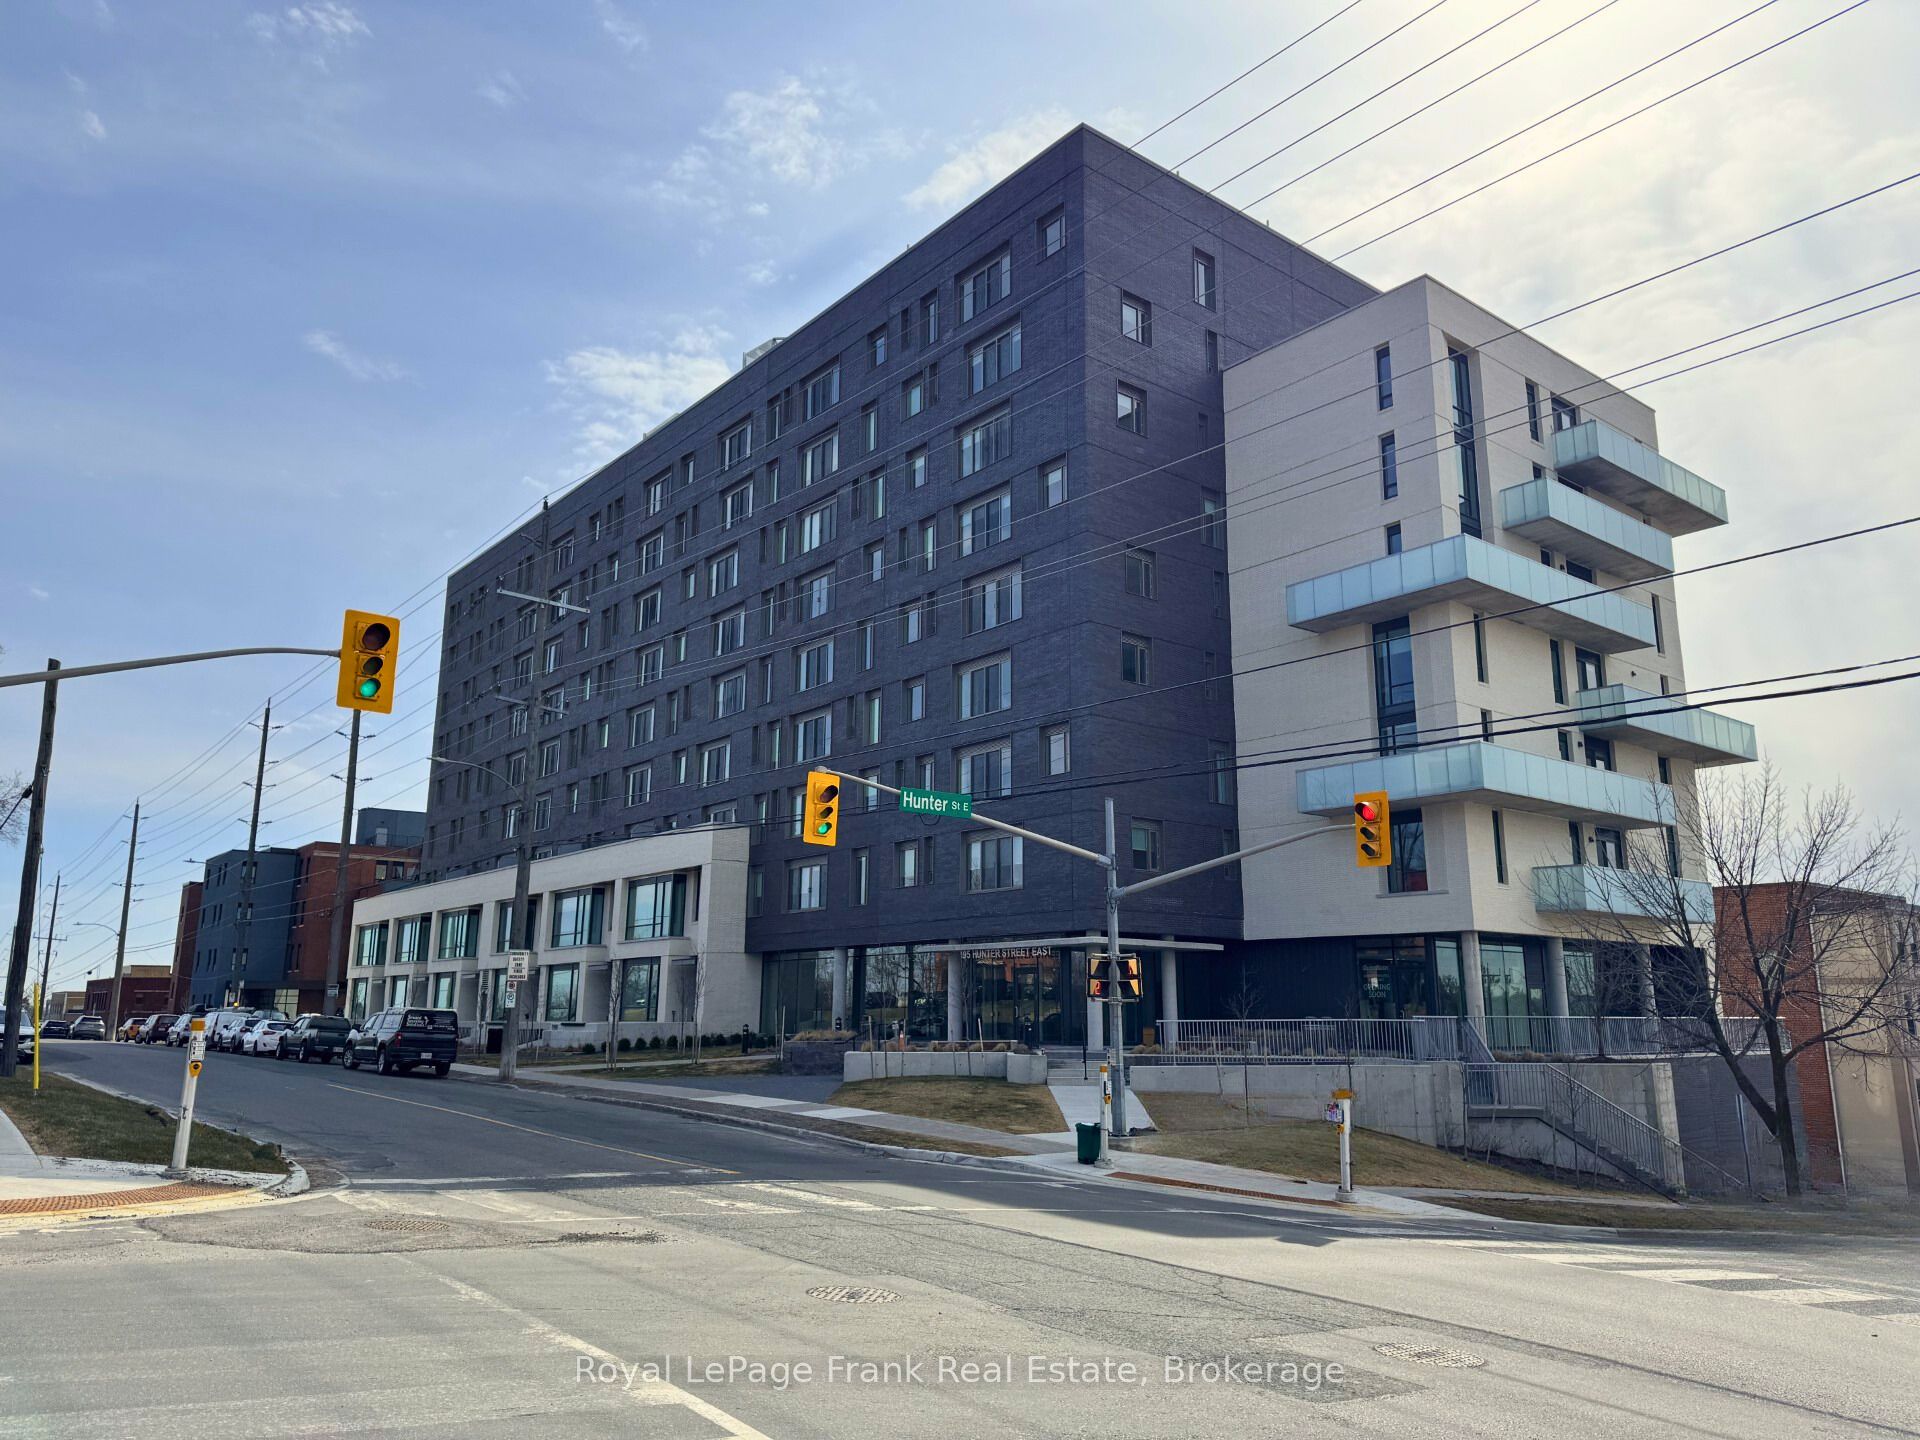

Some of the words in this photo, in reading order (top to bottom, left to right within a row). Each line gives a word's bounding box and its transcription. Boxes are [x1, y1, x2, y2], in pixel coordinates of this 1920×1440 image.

[903, 791, 948, 812] Hunter
[952, 801, 960, 811] St
[963, 803, 969, 812] E
[972, 949, 1001, 959] HUNTER
[1001, 947, 1030, 959] STREET
[1031, 946, 1052, 956] EAST
